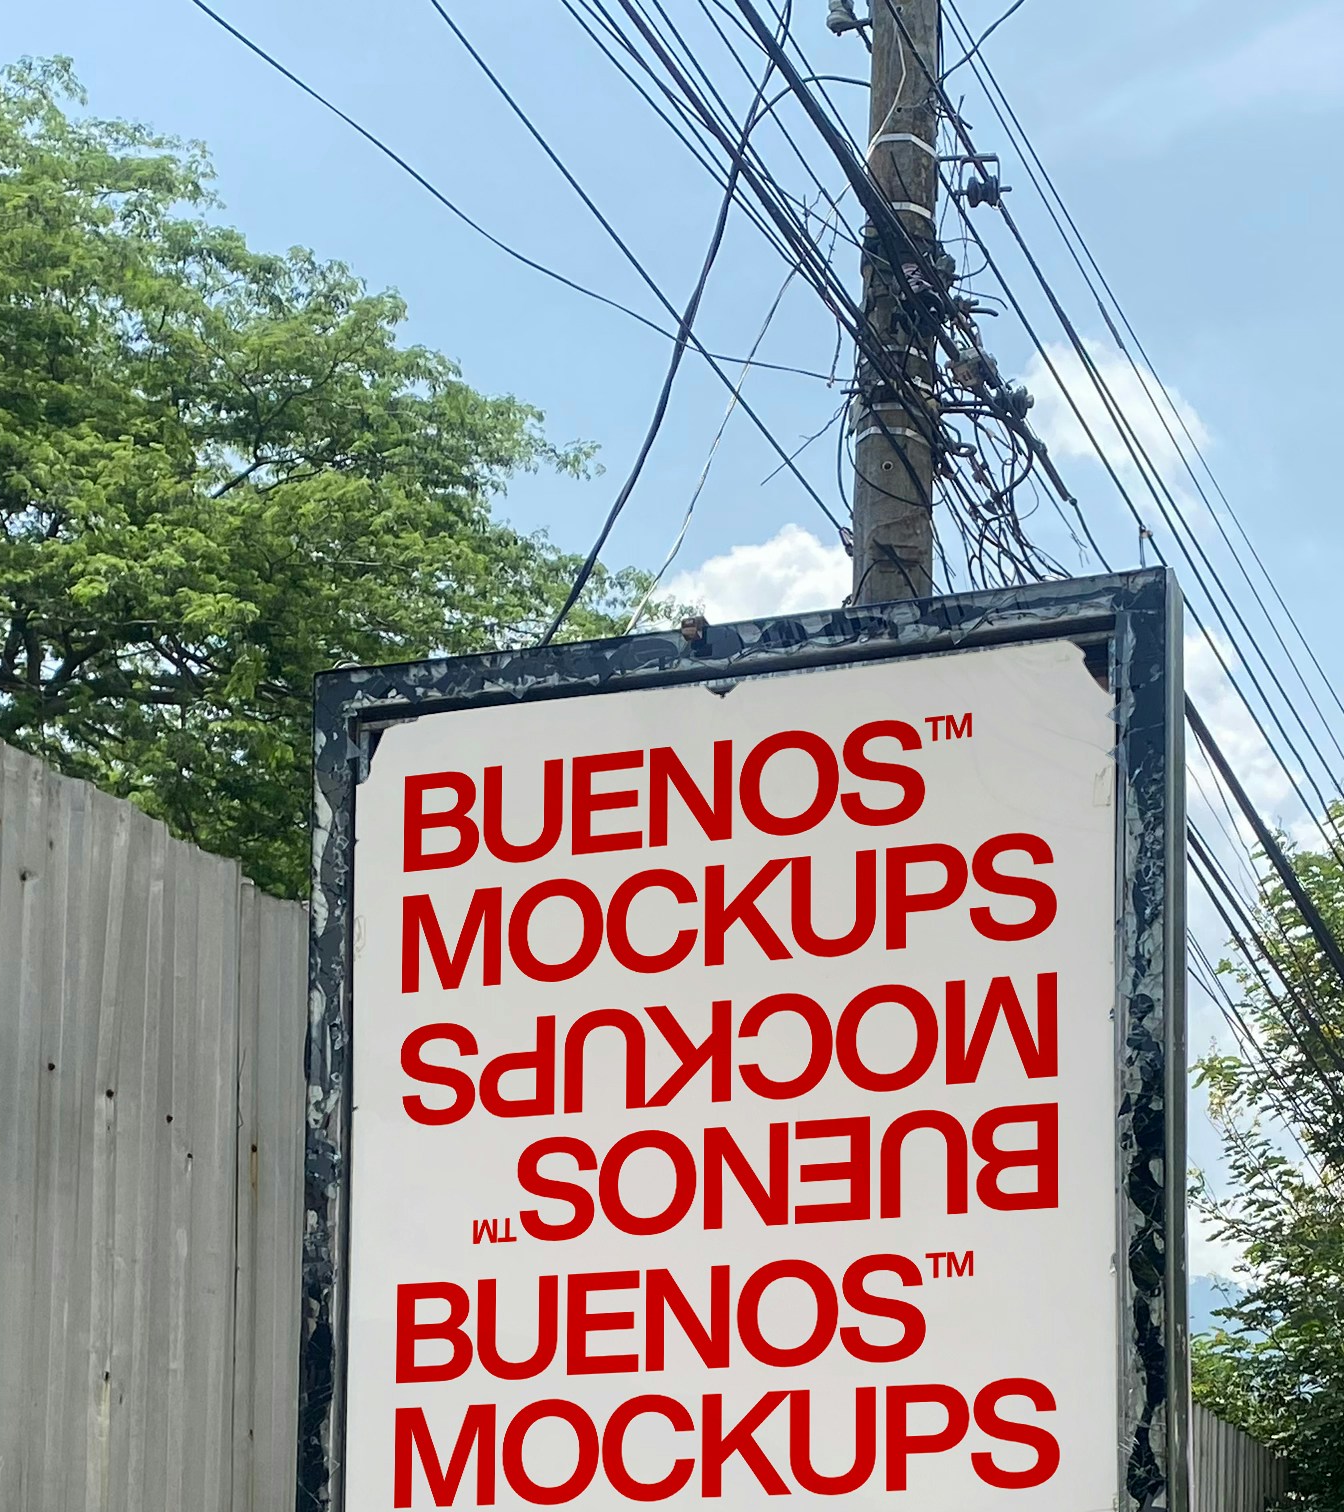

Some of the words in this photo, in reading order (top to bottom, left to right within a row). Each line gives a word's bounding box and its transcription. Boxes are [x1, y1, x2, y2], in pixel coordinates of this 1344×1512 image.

[402, 833, 1057, 993] MOCKUPS
[400, 972, 1058, 1126] MOCKUPS
[394, 1378, 1060, 1508] MOCKUPS
